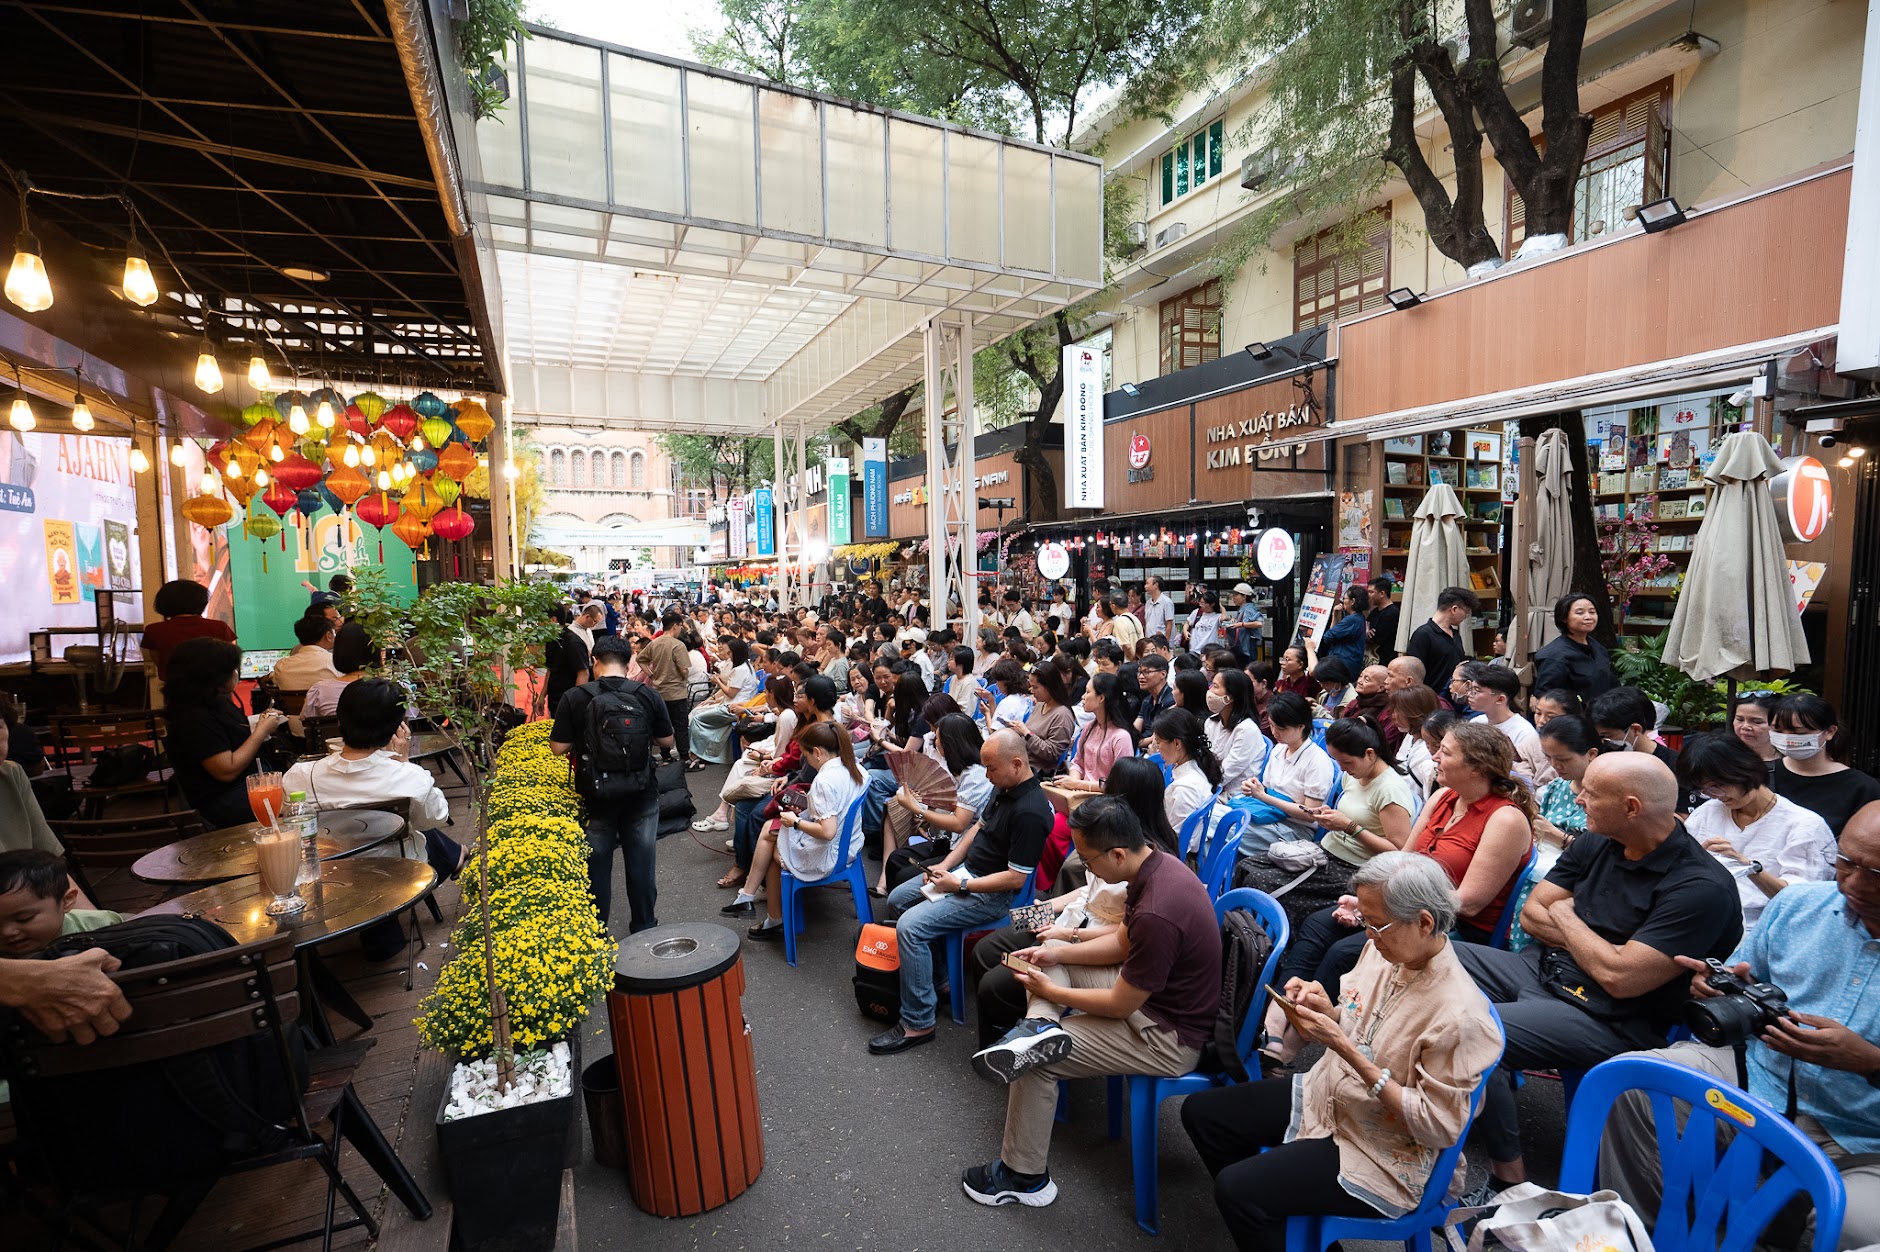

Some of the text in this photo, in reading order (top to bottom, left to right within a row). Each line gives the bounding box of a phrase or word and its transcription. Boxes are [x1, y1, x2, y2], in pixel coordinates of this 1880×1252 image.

[1238, 410, 1274, 437] XUẤT
[1277, 403, 1310, 429] BẢN
[57, 434, 121, 485] AJAHN
[1206, 446, 1241, 470] KIM
[981, 470, 1009, 488] NAM
[8, 489, 21, 508] Tuệ
[21, 491, 33, 507] An
[835, 493, 844, 528] NHÃ NAM
[862, 945, 877, 954] EMG
